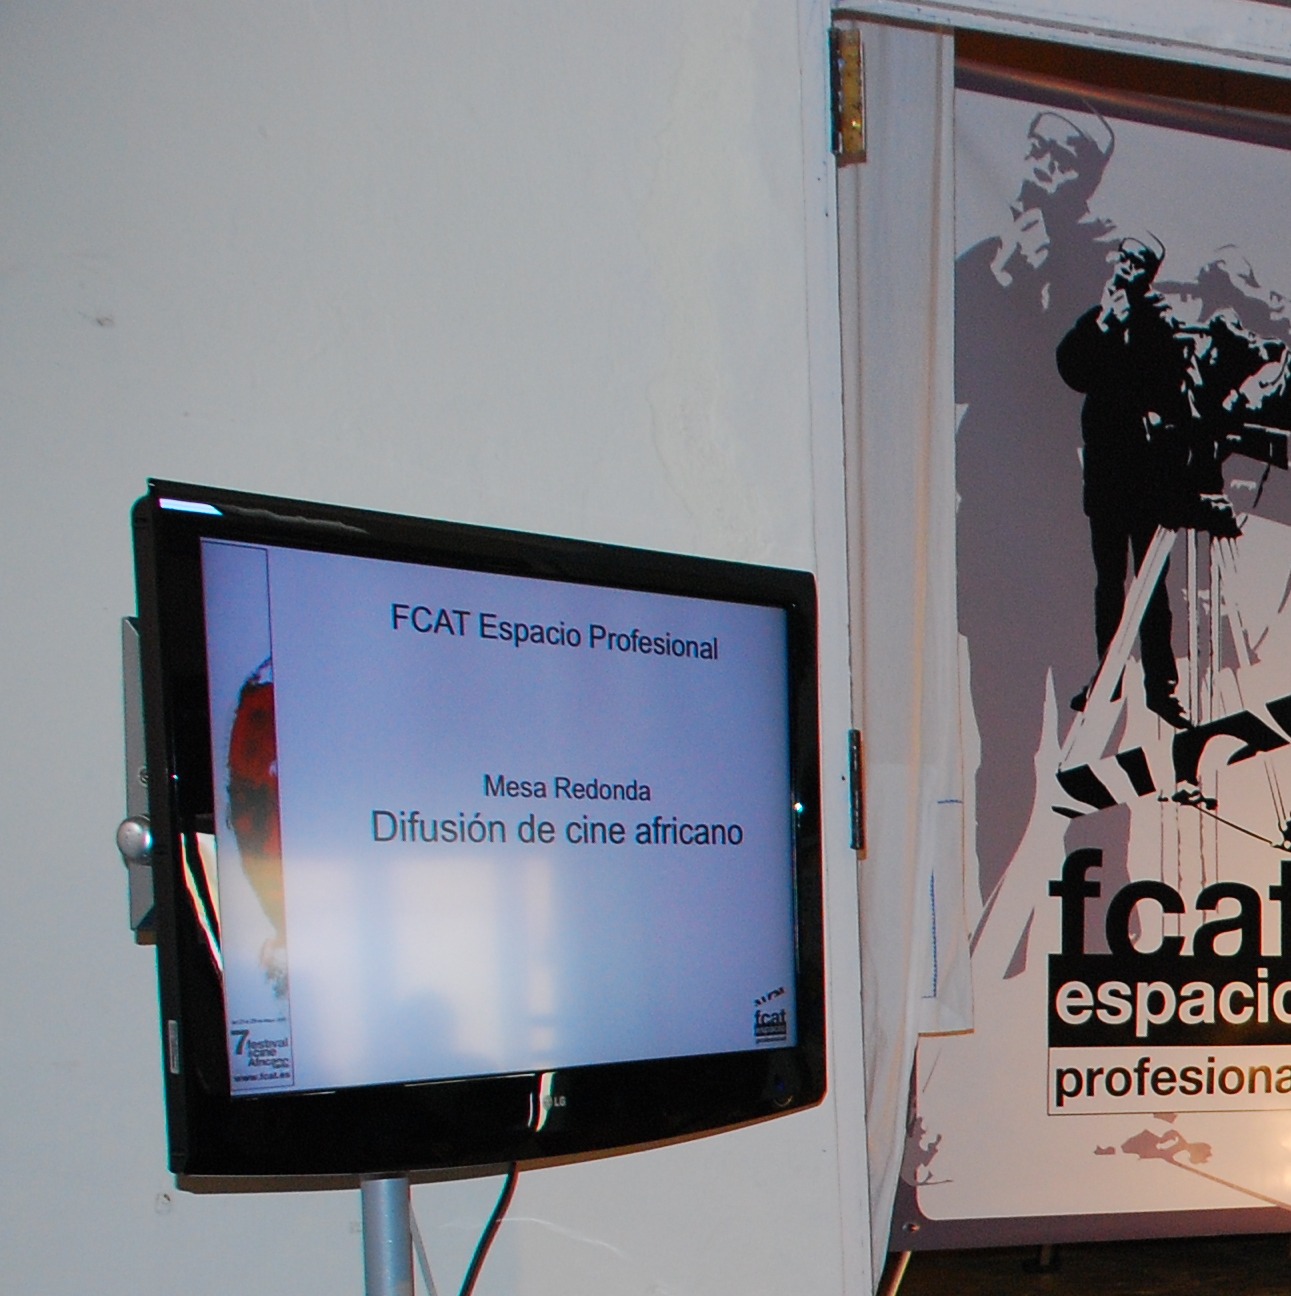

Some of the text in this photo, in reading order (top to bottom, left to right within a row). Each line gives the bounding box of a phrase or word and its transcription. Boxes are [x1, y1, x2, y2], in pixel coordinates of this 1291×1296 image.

[391, 604, 719, 660] FCAT Espacio Profesional
[483, 773, 651, 802] Mesa Redonda
[371, 808, 743, 847] Difusión de cine africano
[754, 1009, 786, 1025] fcat
[230, 1029, 250, 1055] 7
[554, 1095, 566, 1107] LG
